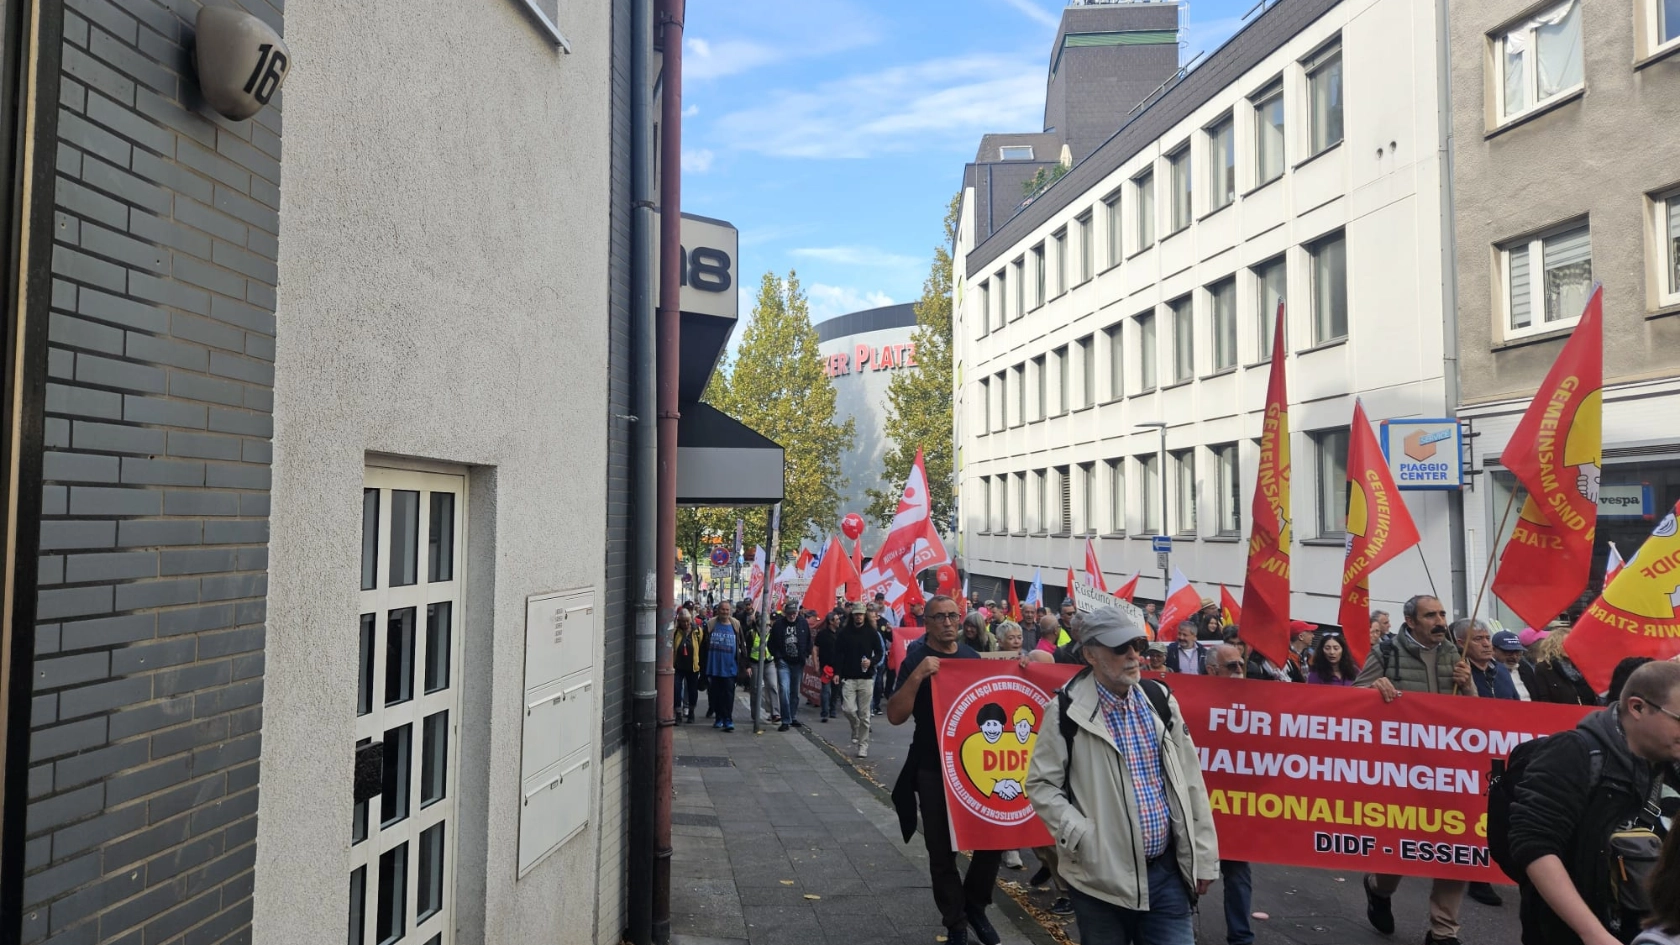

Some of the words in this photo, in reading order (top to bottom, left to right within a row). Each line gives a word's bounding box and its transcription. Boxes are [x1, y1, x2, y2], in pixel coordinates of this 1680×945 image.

[243, 44, 287, 106] 16
[855, 343, 919, 373] PLATZ
[1538, 375, 1580, 493] GEMEINSAM
[1400, 463, 1448, 472] PIAGGIO
[1400, 472, 1448, 480] CENTER
[1548, 493, 1586, 531] SIND
[1600, 495, 1640, 506] vespa
[1074, 581, 1111, 607] Rüstung
[1208, 703, 1272, 736] FÜR
[1279, 713, 1373, 744] MEHR
[982, 749, 1029, 772] DIDF
[1196, 746, 1480, 795] IALWOHNUNGEN
[1314, 831, 1376, 857] DIDF
[1400, 838, 1490, 867] ESSEN
